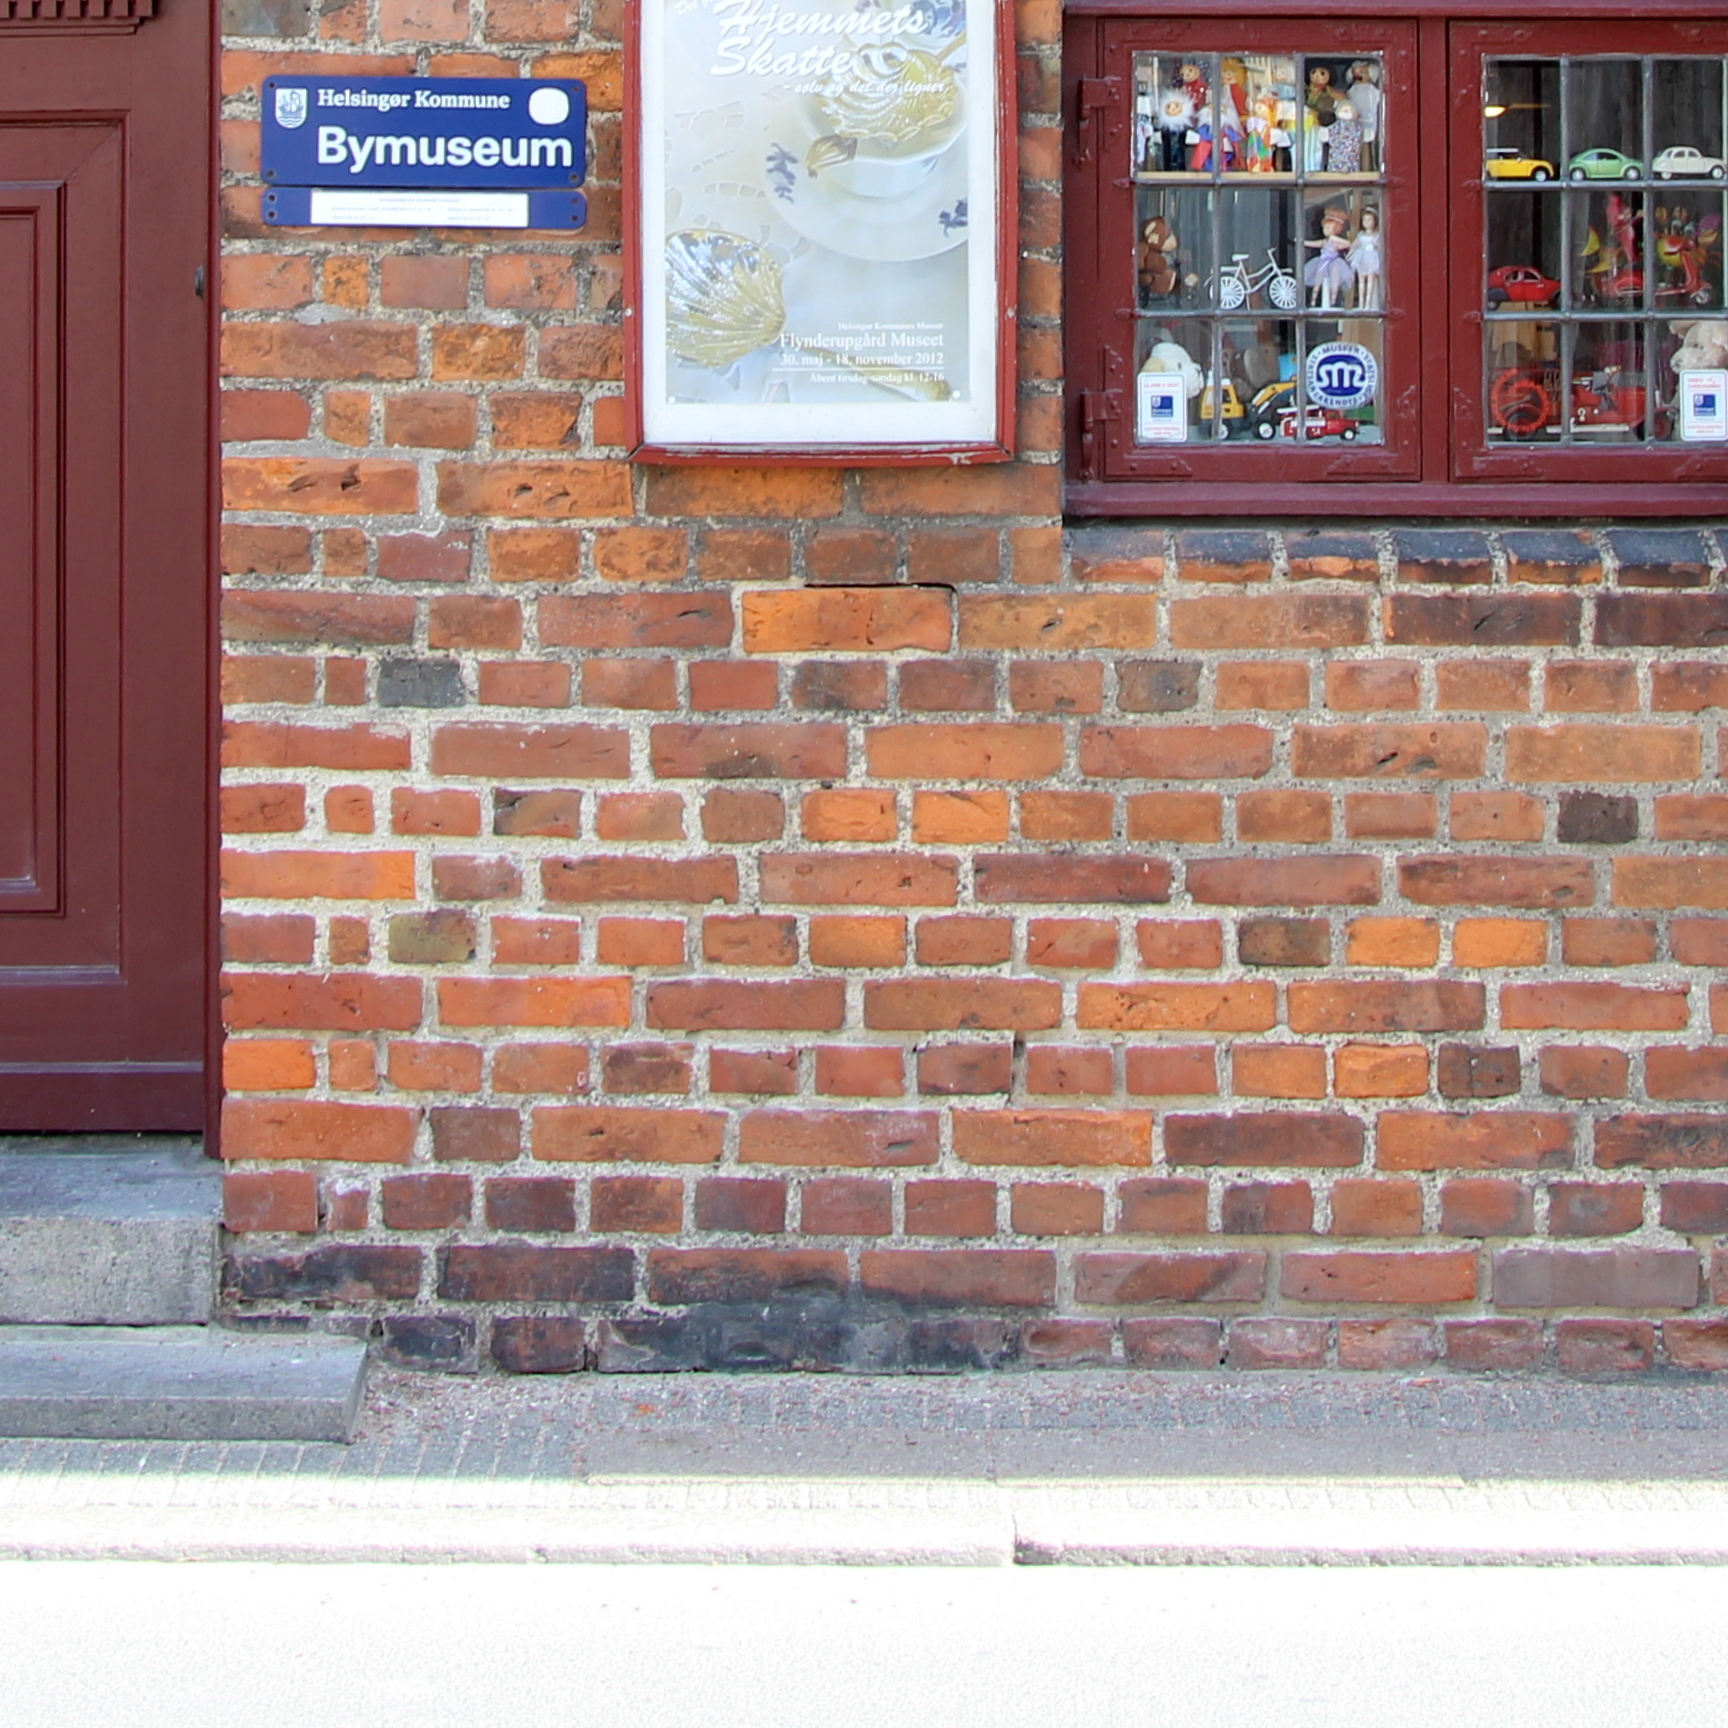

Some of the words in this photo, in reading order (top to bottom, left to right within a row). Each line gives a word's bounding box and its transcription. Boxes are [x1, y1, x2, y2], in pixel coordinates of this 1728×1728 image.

[675, 0, 698, 15] Det
[709, 35, 854, 76] Skatte
[317, 88, 411, 112] Helsingør
[414, 90, 511, 109] Kommune
[318, 125, 573, 174] Bymuseum
[780, 332, 886, 351] Flynderupgård
[890, 333, 944, 348] Museet
[780, 354, 799, 366] 30.
[802, 354, 824, 368] maj
[855, 353, 913, 366] november
[915, 352, 944, 365] 2012
